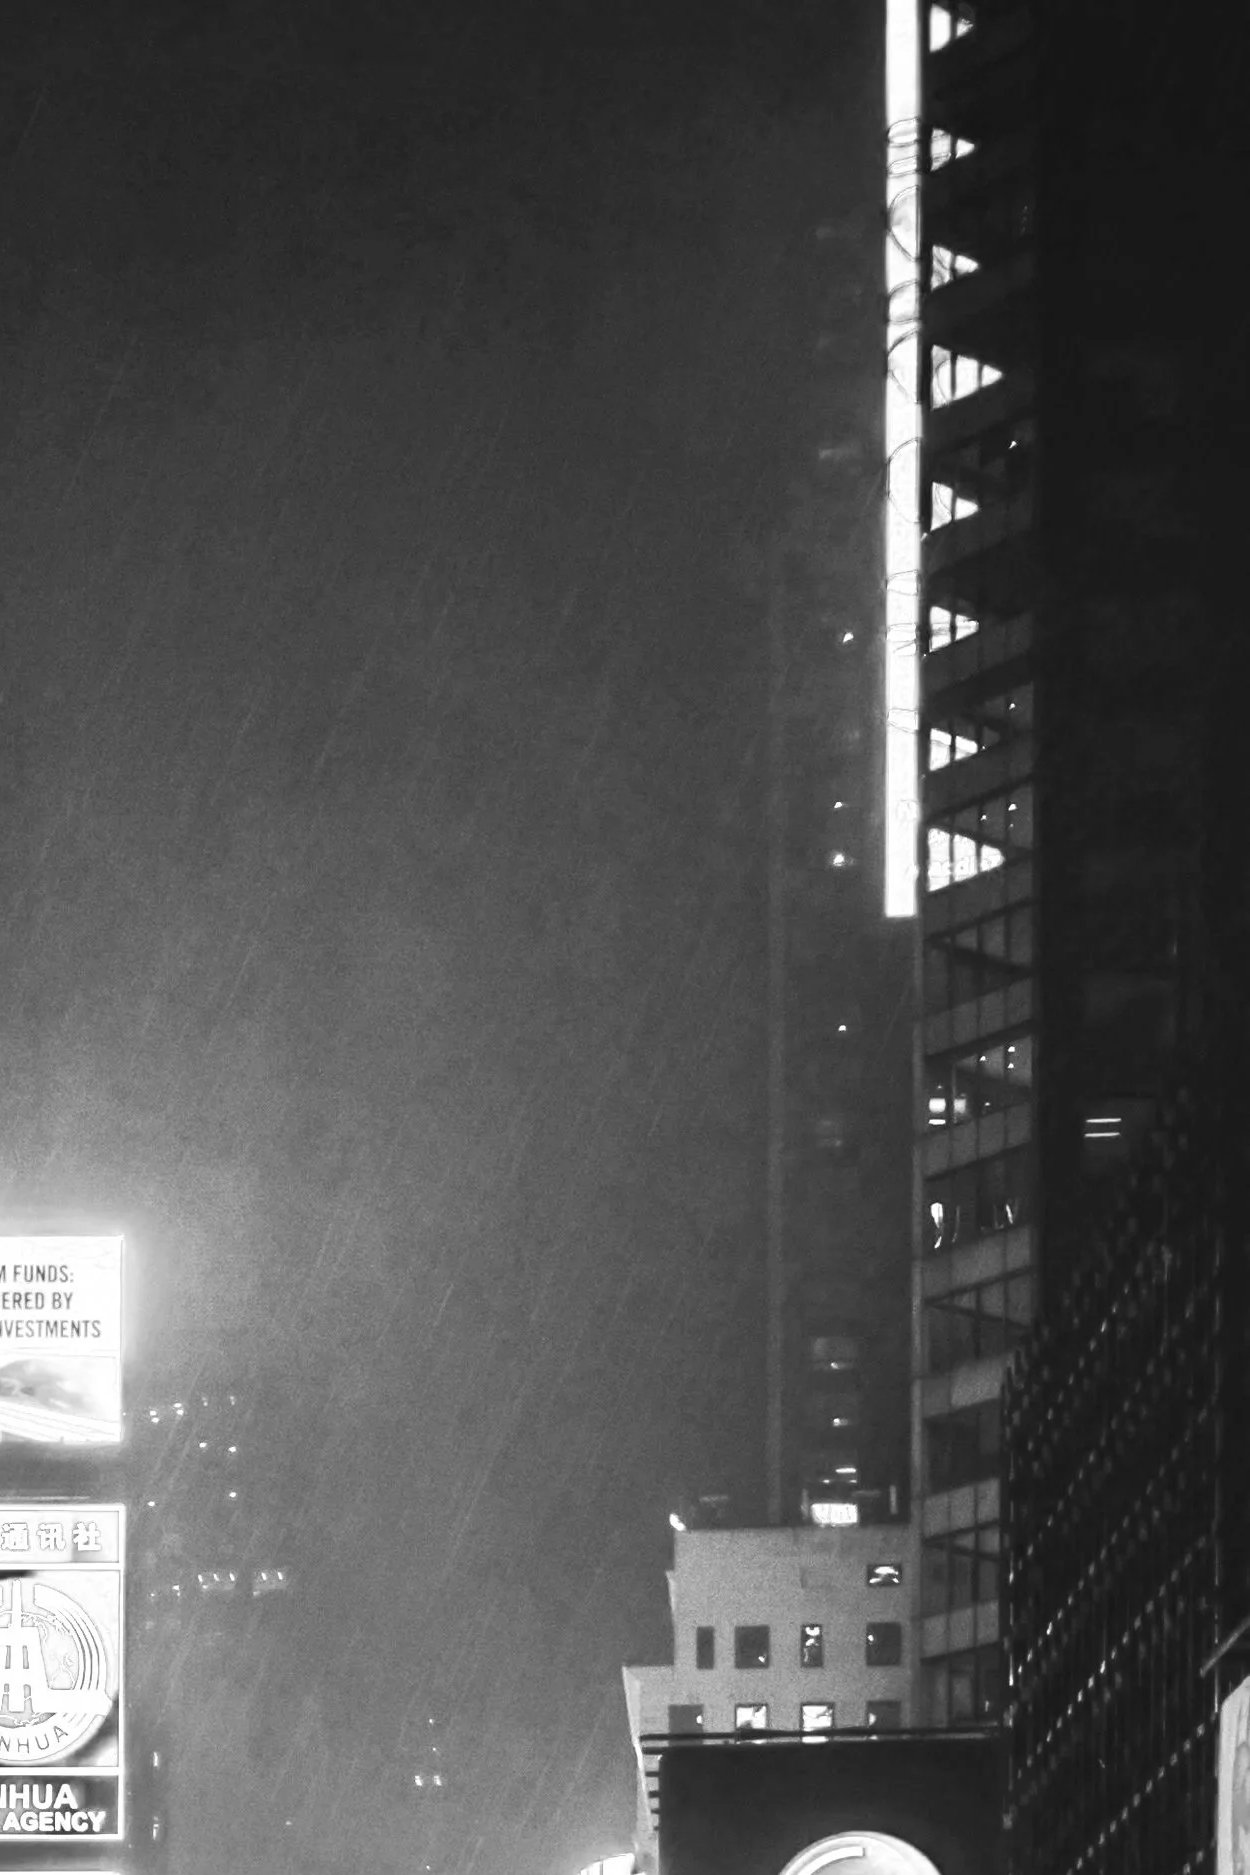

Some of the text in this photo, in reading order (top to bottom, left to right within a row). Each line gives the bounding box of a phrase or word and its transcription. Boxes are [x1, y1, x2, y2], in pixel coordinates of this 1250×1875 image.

[13, 1265, 74, 1283] FUNDS:
[52, 1292, 74, 1310] BY
[2, 1811, 107, 1833] AGENCY
